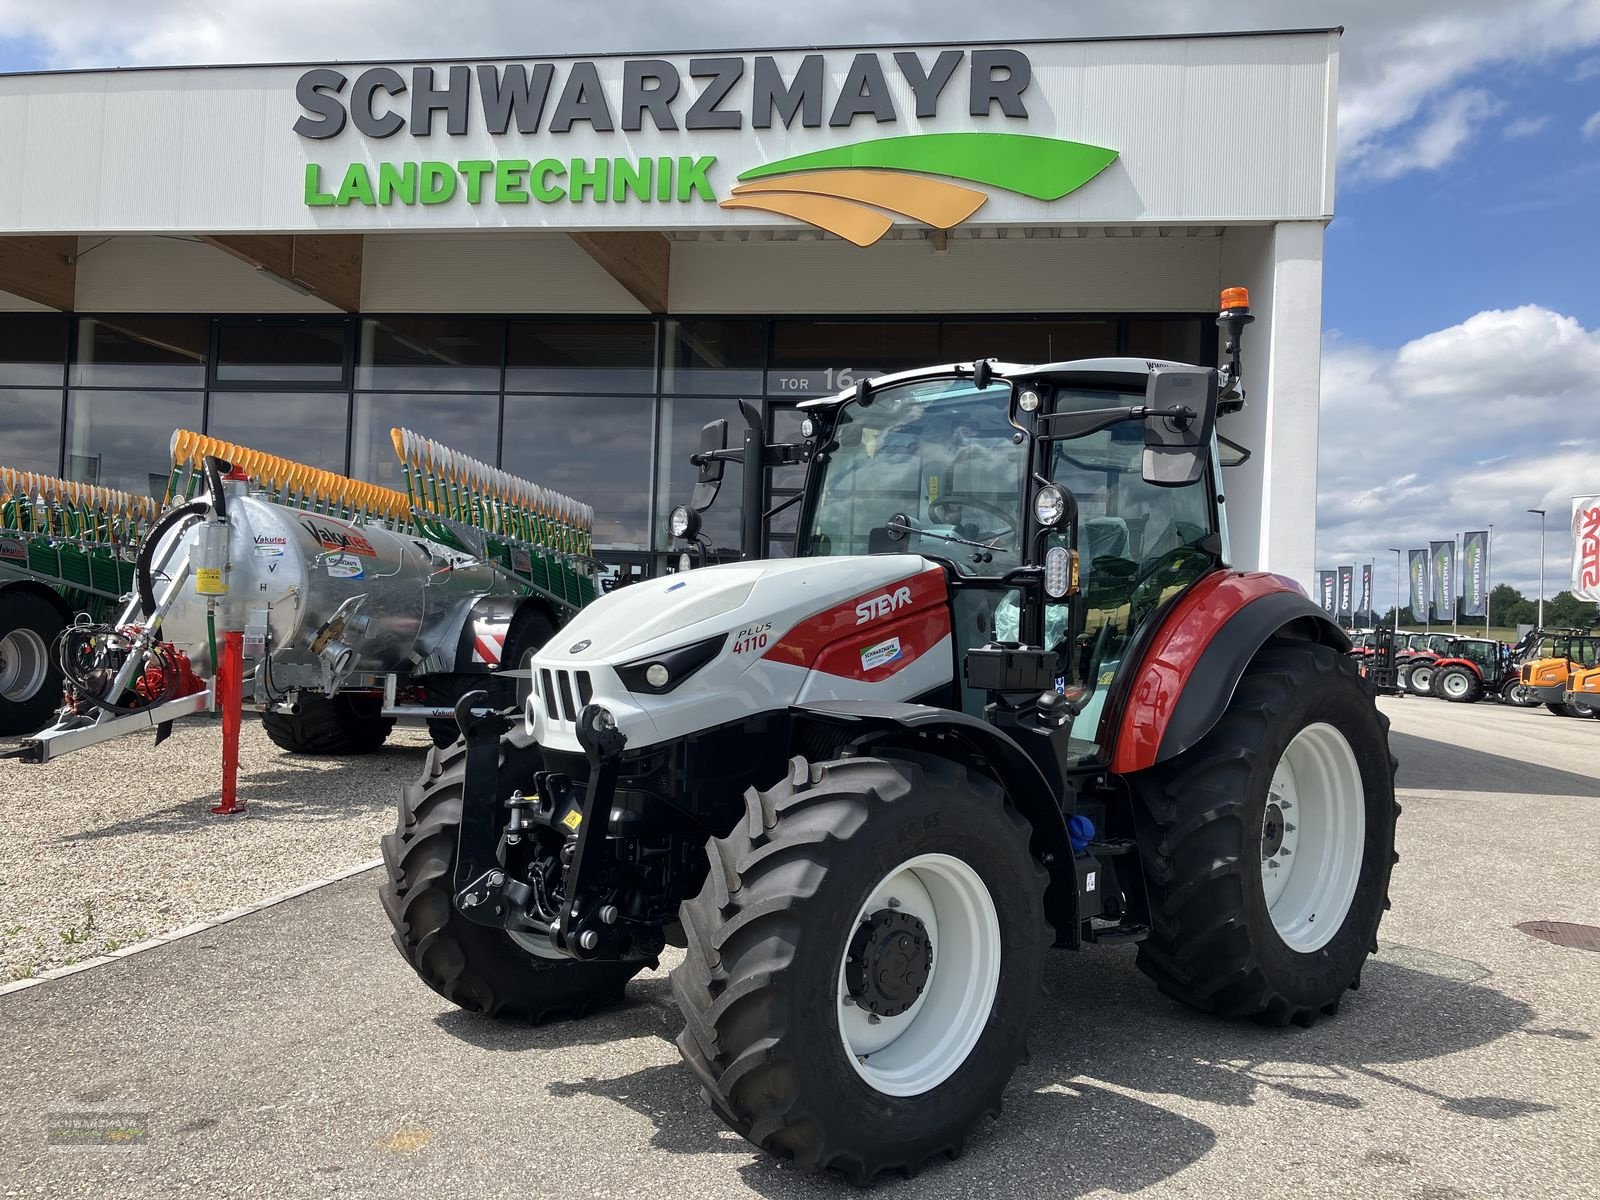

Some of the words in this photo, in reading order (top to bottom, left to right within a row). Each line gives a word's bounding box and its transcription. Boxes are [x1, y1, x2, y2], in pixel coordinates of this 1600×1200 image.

[292, 48, 1032, 139] SCHWARZMAYR
[304, 155, 717, 207] LANDTECHNIK
[780, 378, 809, 390] TOR
[823, 367, 855, 390] 16
[253, 534, 287, 544] Vakutec
[300, 519, 374, 551] Vakutec
[855, 586, 913, 626] STEYR
[738, 621, 772, 639] PLUS
[732, 633, 768, 655] 4110
[864, 643, 895, 659] SCHWARZMAYR
